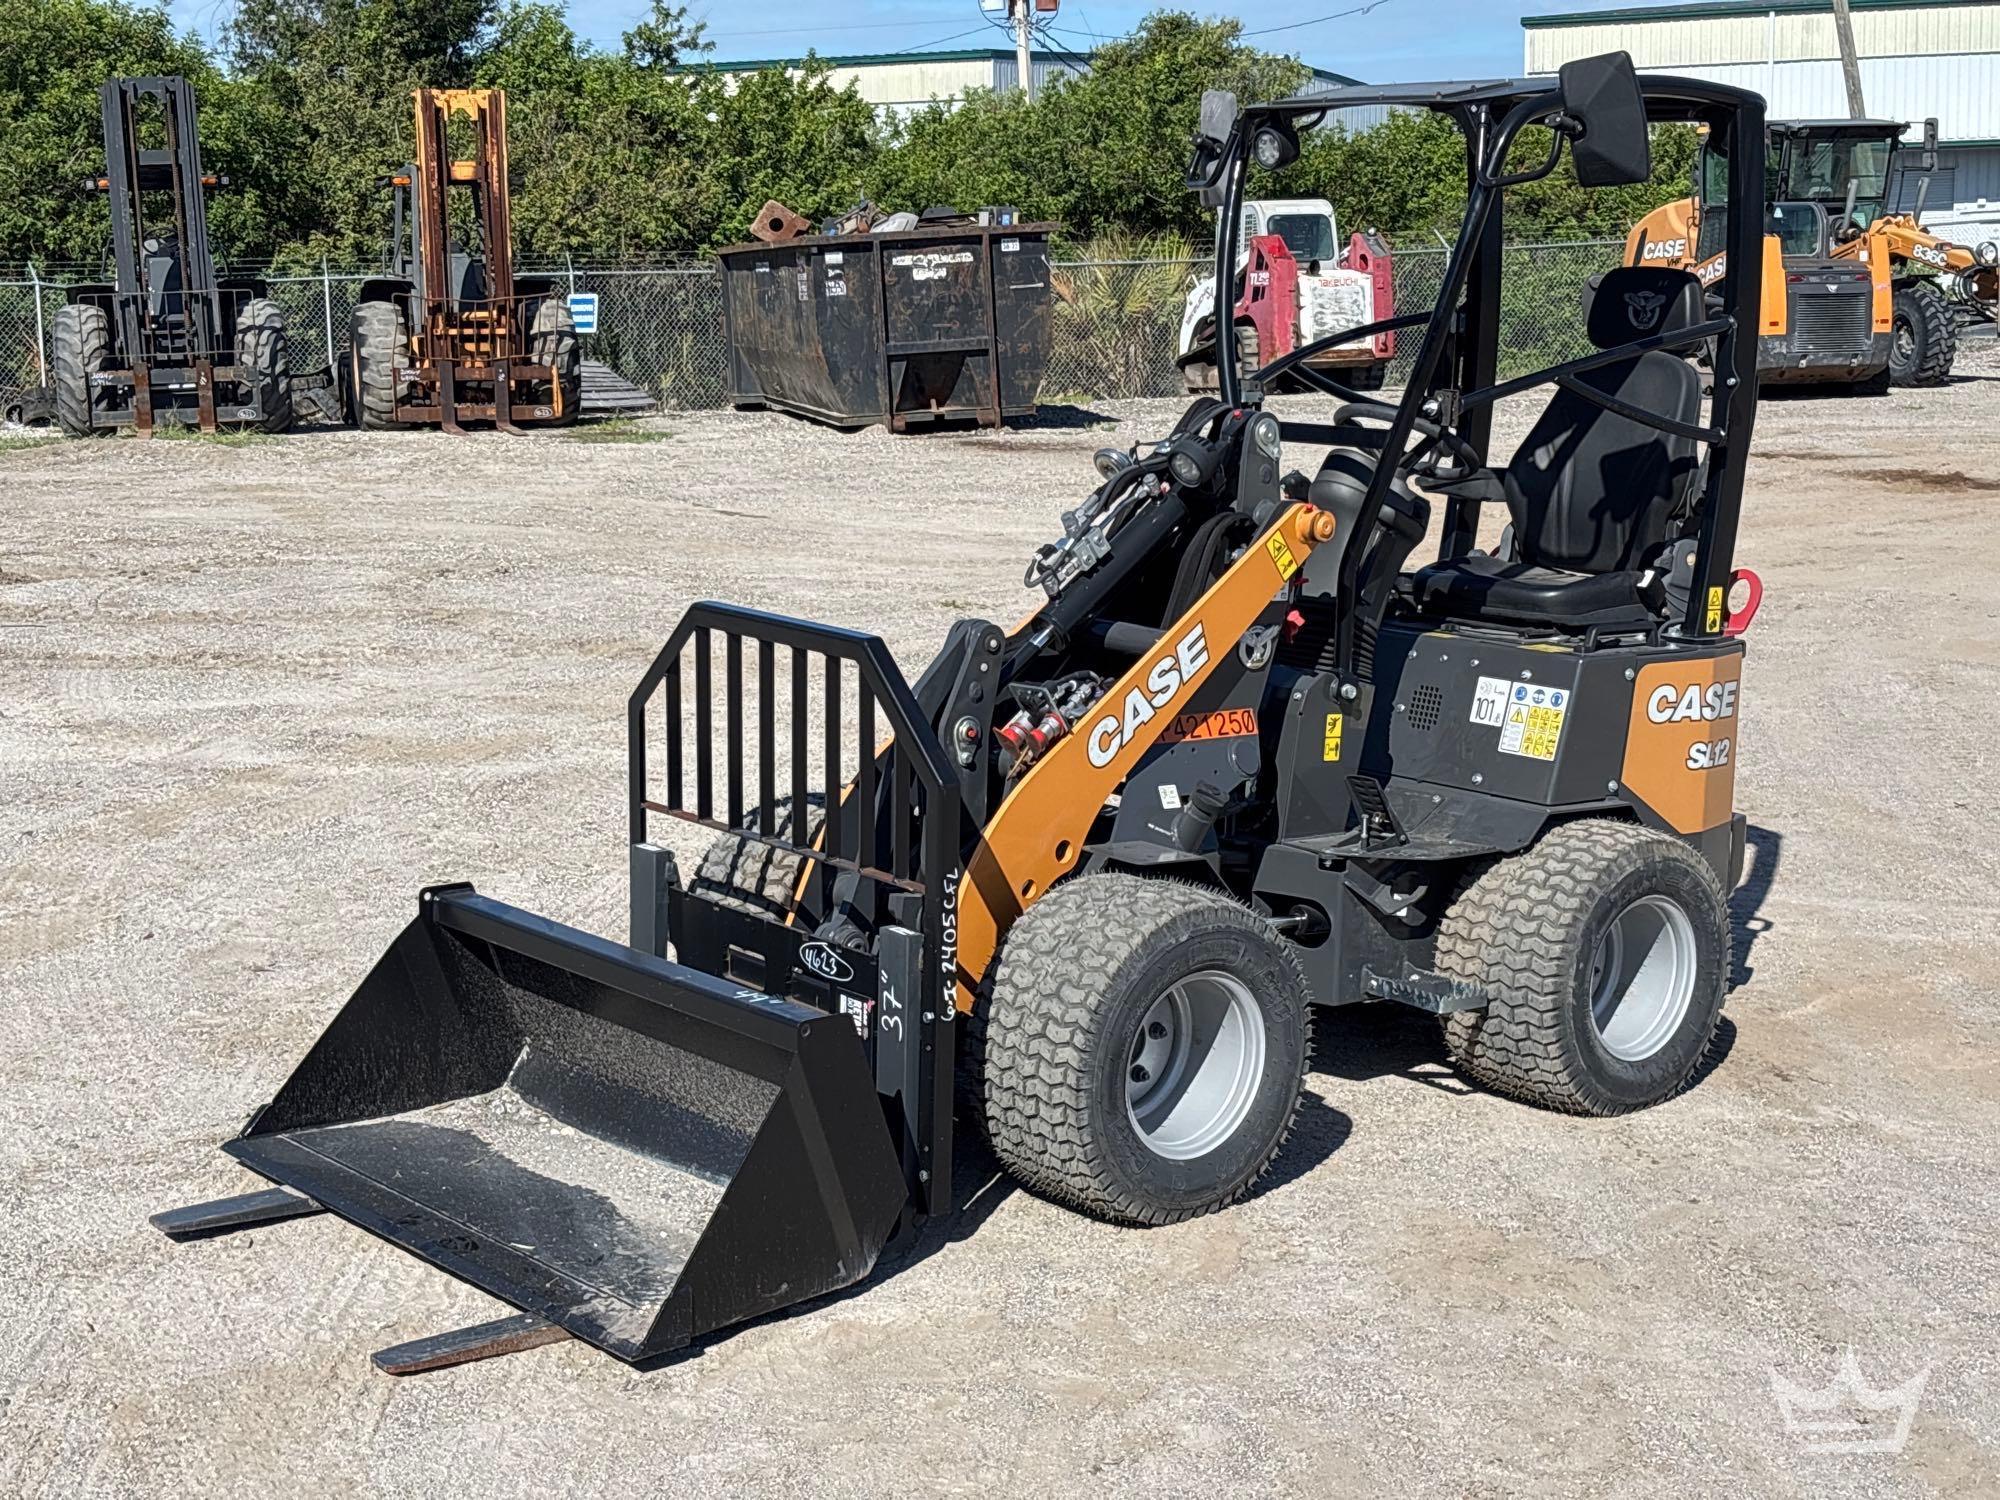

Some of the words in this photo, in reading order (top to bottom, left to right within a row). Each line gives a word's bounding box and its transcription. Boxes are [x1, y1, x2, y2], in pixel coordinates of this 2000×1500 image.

[1643, 238, 1686, 260] CASE
[1912, 243, 1948, 267] 836C
[1697, 255, 1726, 282] CAS
[1086, 620, 1210, 768] CASE
[1647, 679, 1738, 724] CASE
[1475, 697, 1495, 722] 101
[1685, 737, 1730, 770] SL12
[805, 948, 837, 975] 4623
